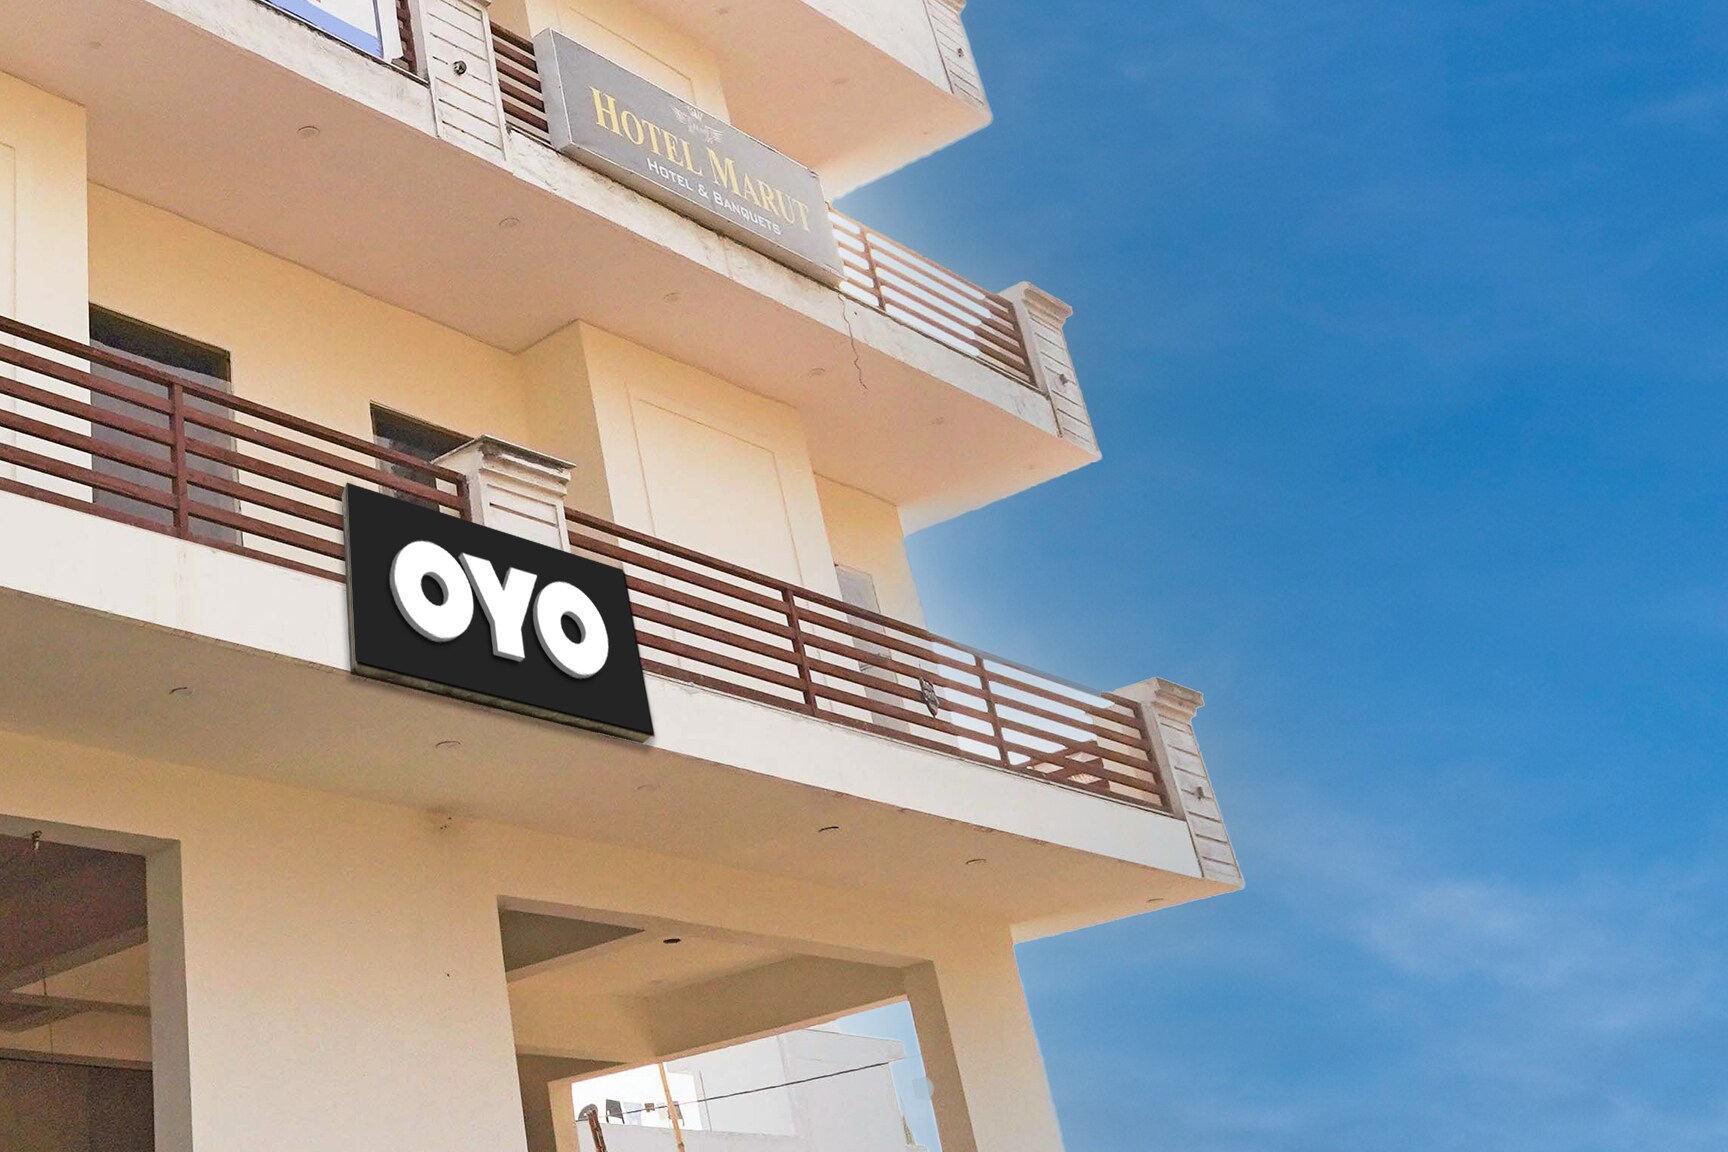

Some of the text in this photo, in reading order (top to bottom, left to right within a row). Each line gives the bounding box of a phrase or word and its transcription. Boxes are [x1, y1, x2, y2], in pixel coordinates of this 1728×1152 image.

[647, 158, 782, 236] HOTEL & BANQUETS
[389, 540, 609, 680] OYO
